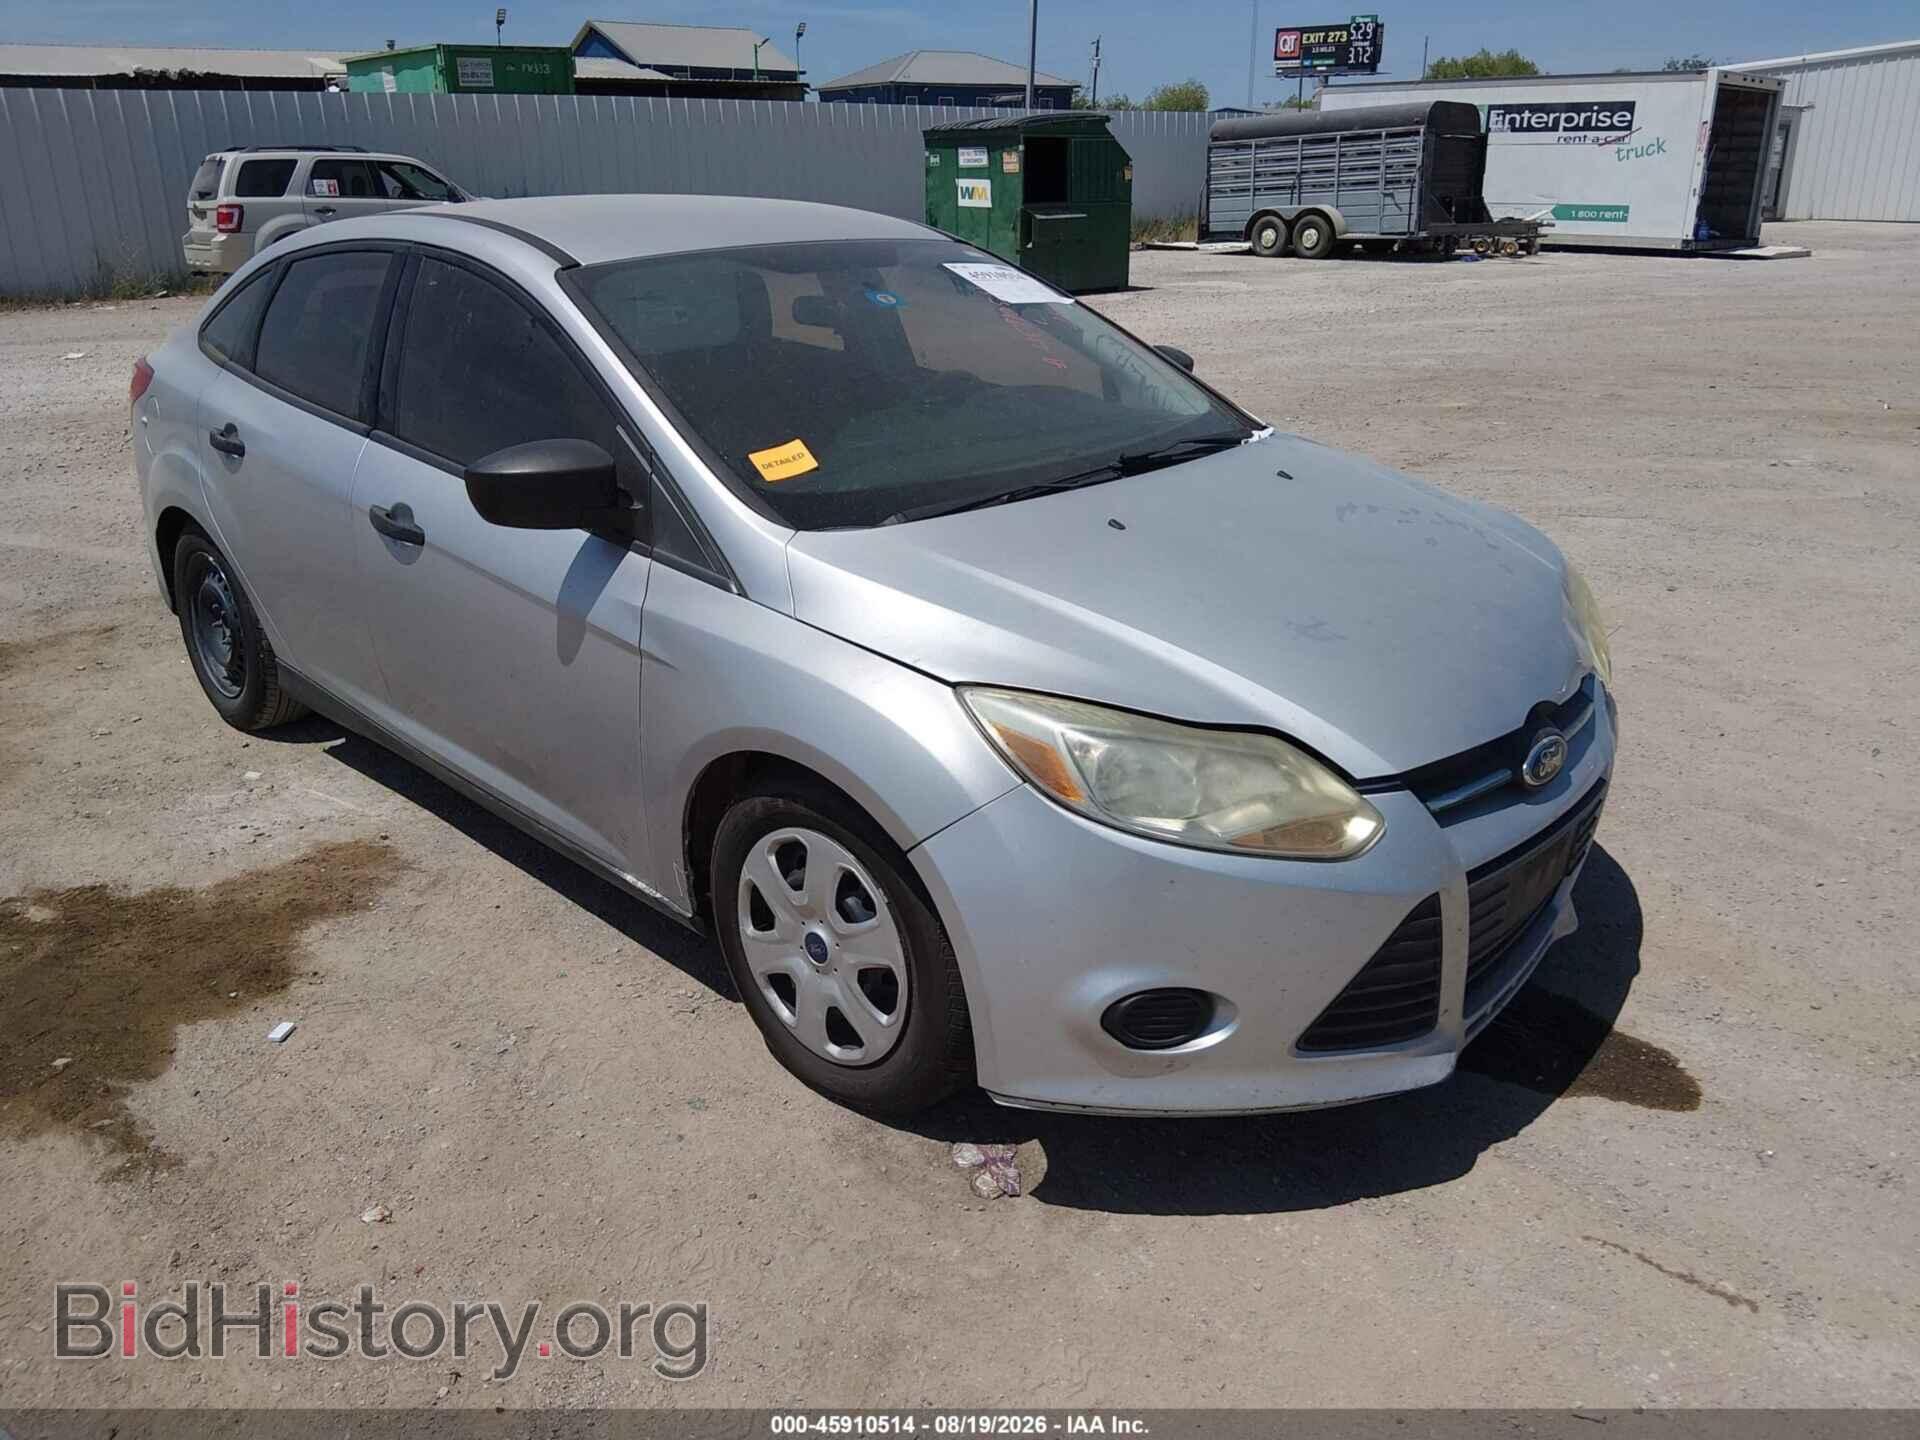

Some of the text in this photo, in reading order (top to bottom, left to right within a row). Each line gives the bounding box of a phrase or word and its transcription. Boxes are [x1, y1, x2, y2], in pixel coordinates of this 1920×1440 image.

[1280, 35, 1297, 53] QT
[1302, 31, 1348, 44] EXIT 273
[1489, 105, 1632, 132] Enterprise
[1616, 137, 1667, 162] truck
[960, 186, 988, 200] WM
[761, 452, 805, 470] DETAILED
